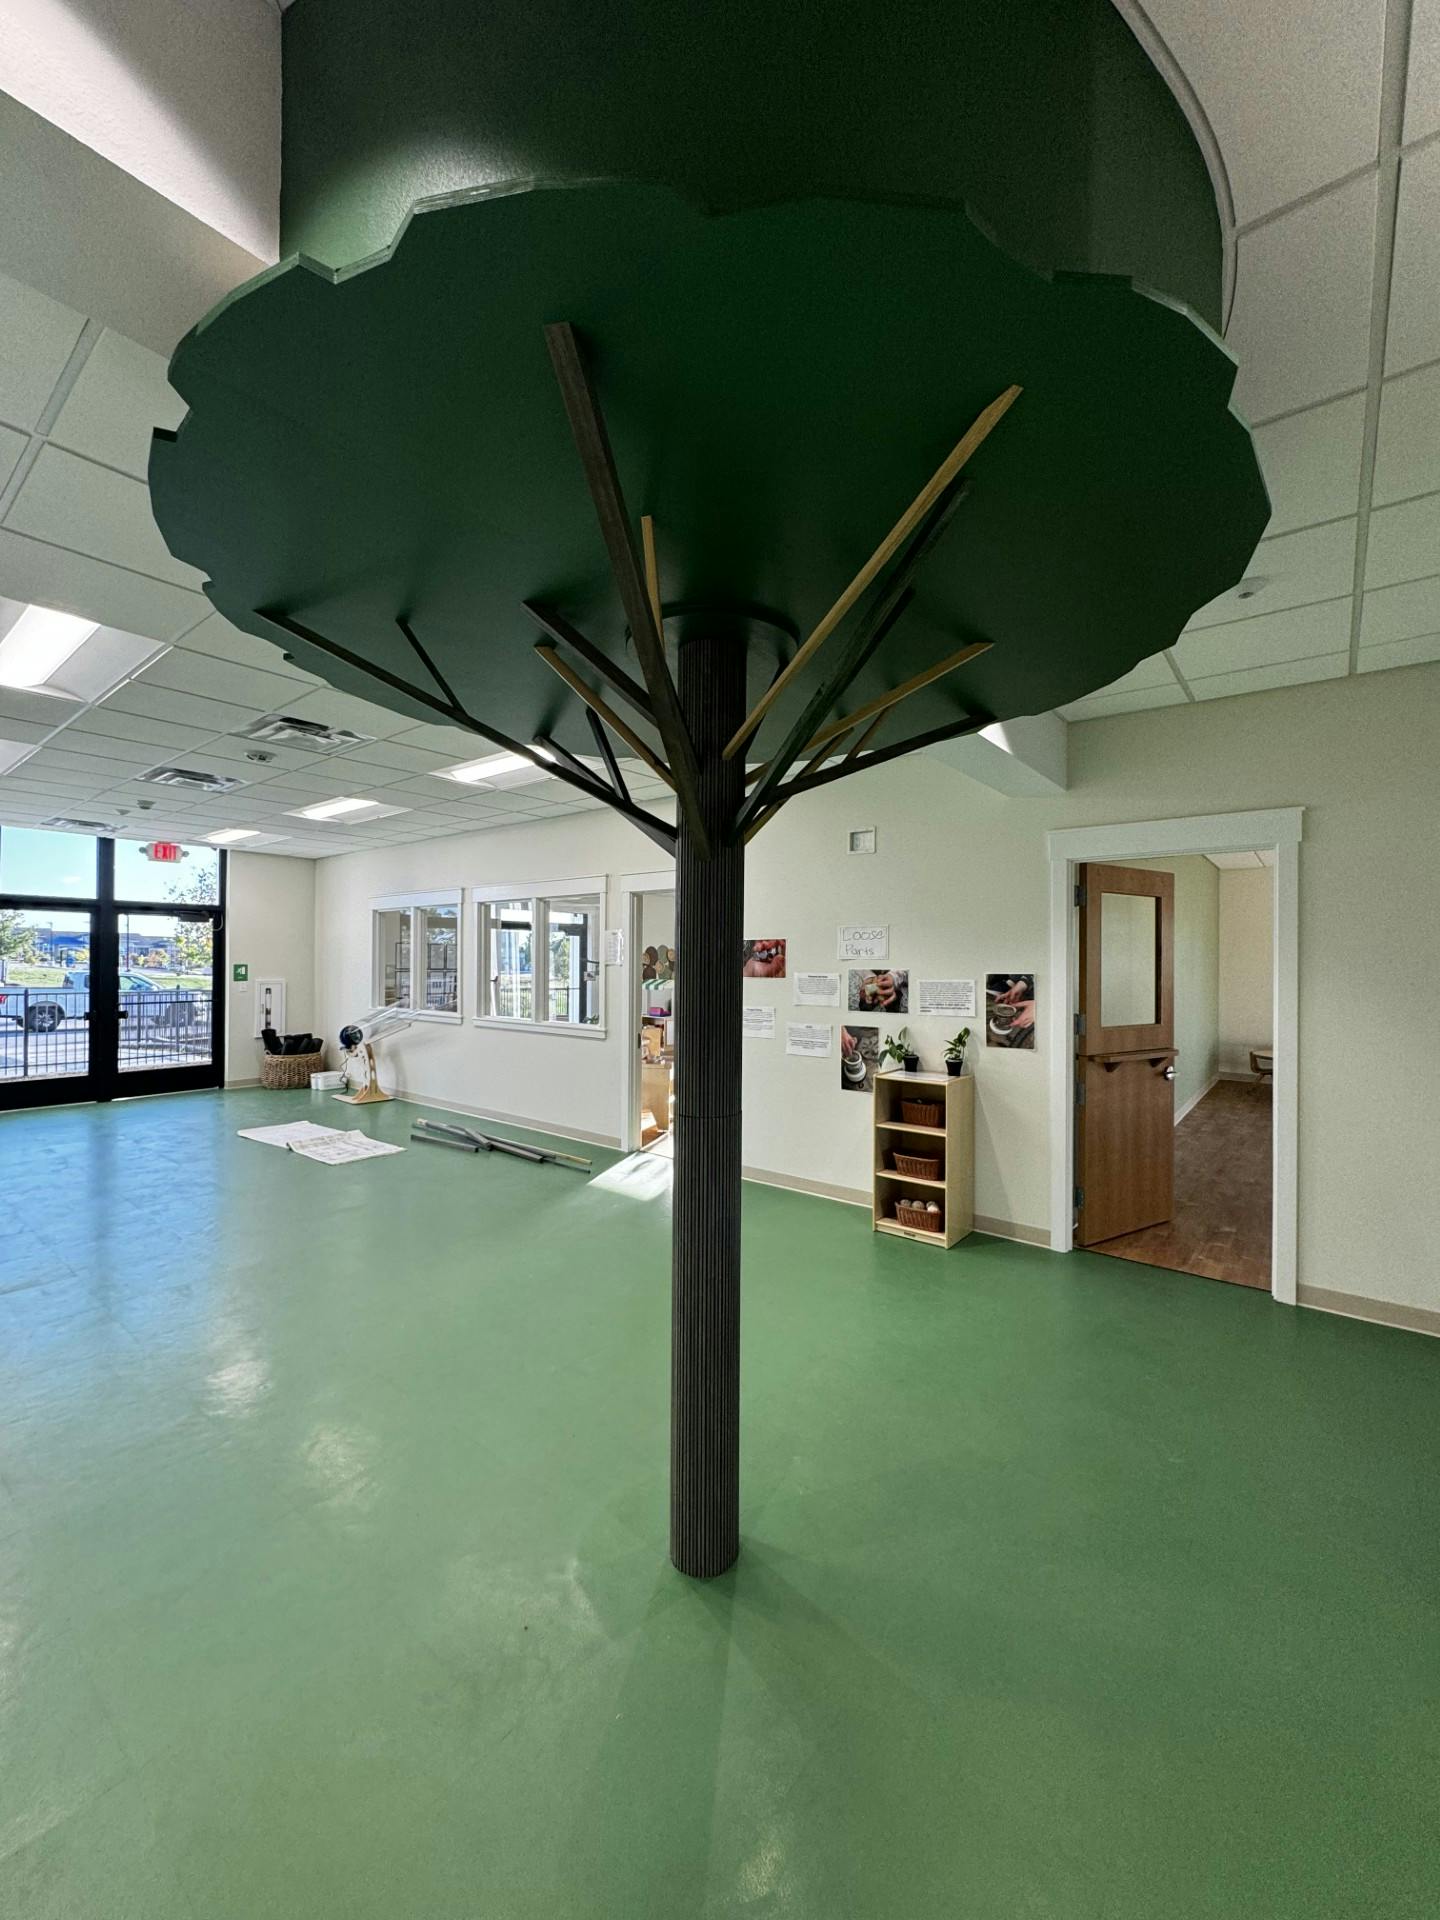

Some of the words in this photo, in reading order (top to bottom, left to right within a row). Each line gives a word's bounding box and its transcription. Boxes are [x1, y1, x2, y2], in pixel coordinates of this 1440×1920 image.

[154, 844, 176, 861] EXIT
[843, 928, 884, 941] Loose
[846, 944, 874, 956] Parts
